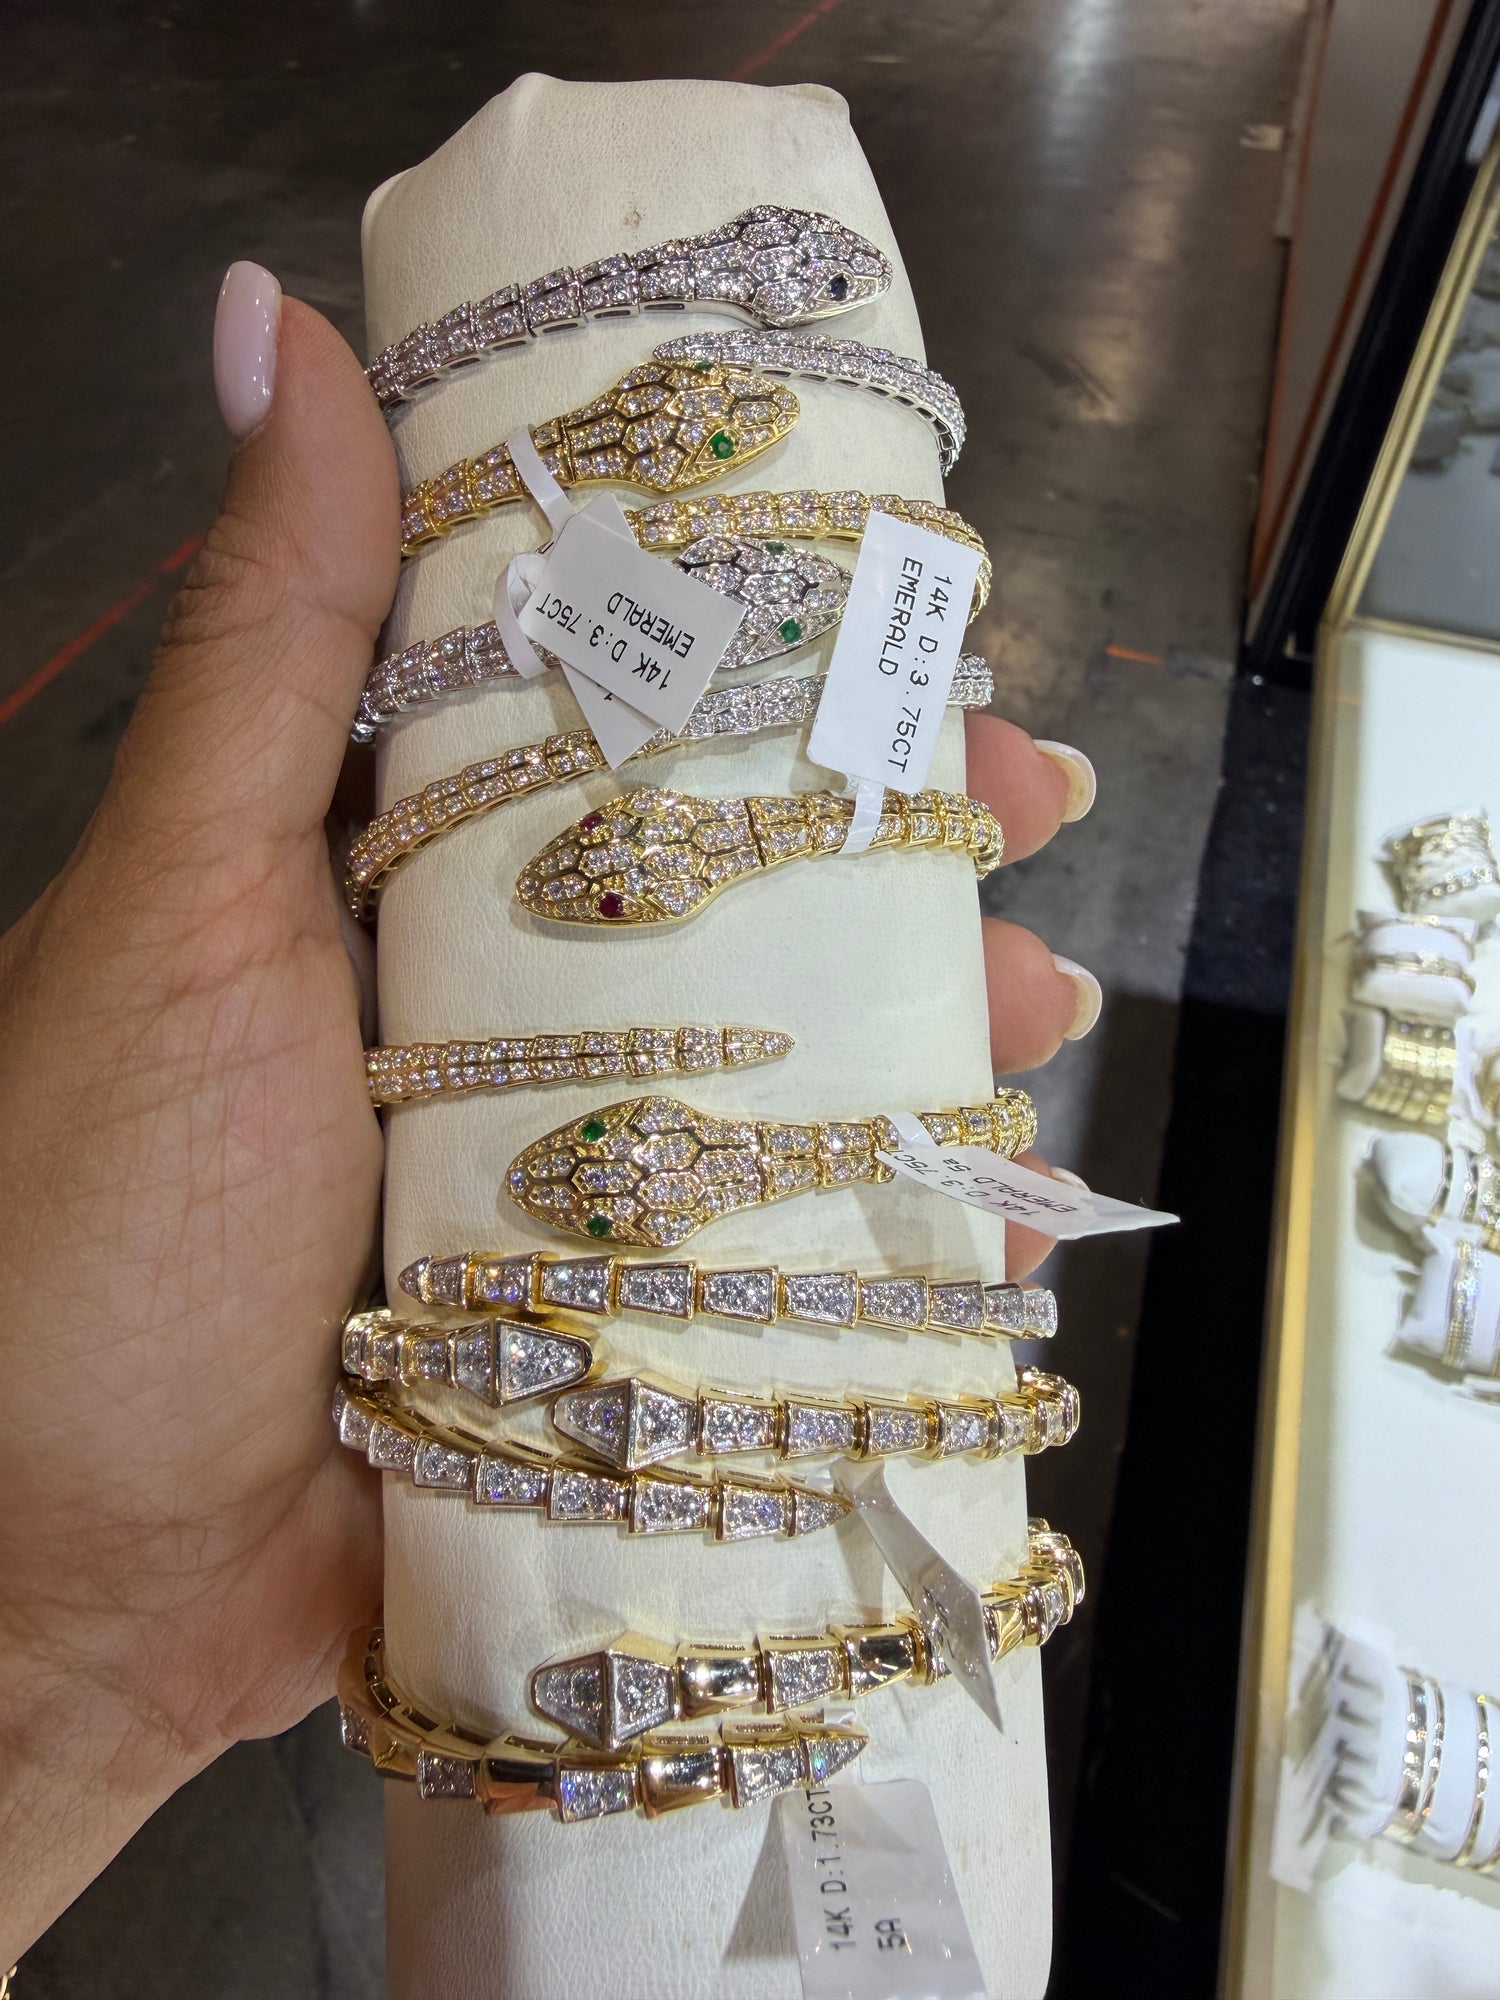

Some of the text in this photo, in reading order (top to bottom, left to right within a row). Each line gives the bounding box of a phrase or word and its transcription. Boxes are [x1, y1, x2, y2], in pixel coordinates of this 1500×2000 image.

[877, 556, 923, 676] EMERALD
[925, 575, 953, 622] 14K
[606, 591, 695, 659] EMERALD
[631, 652, 673, 690] 14K
[973, 1177, 1078, 1212] EMERALD
[988, 1200, 1041, 1215] 14K
[823, 1906, 856, 1951] 14K
